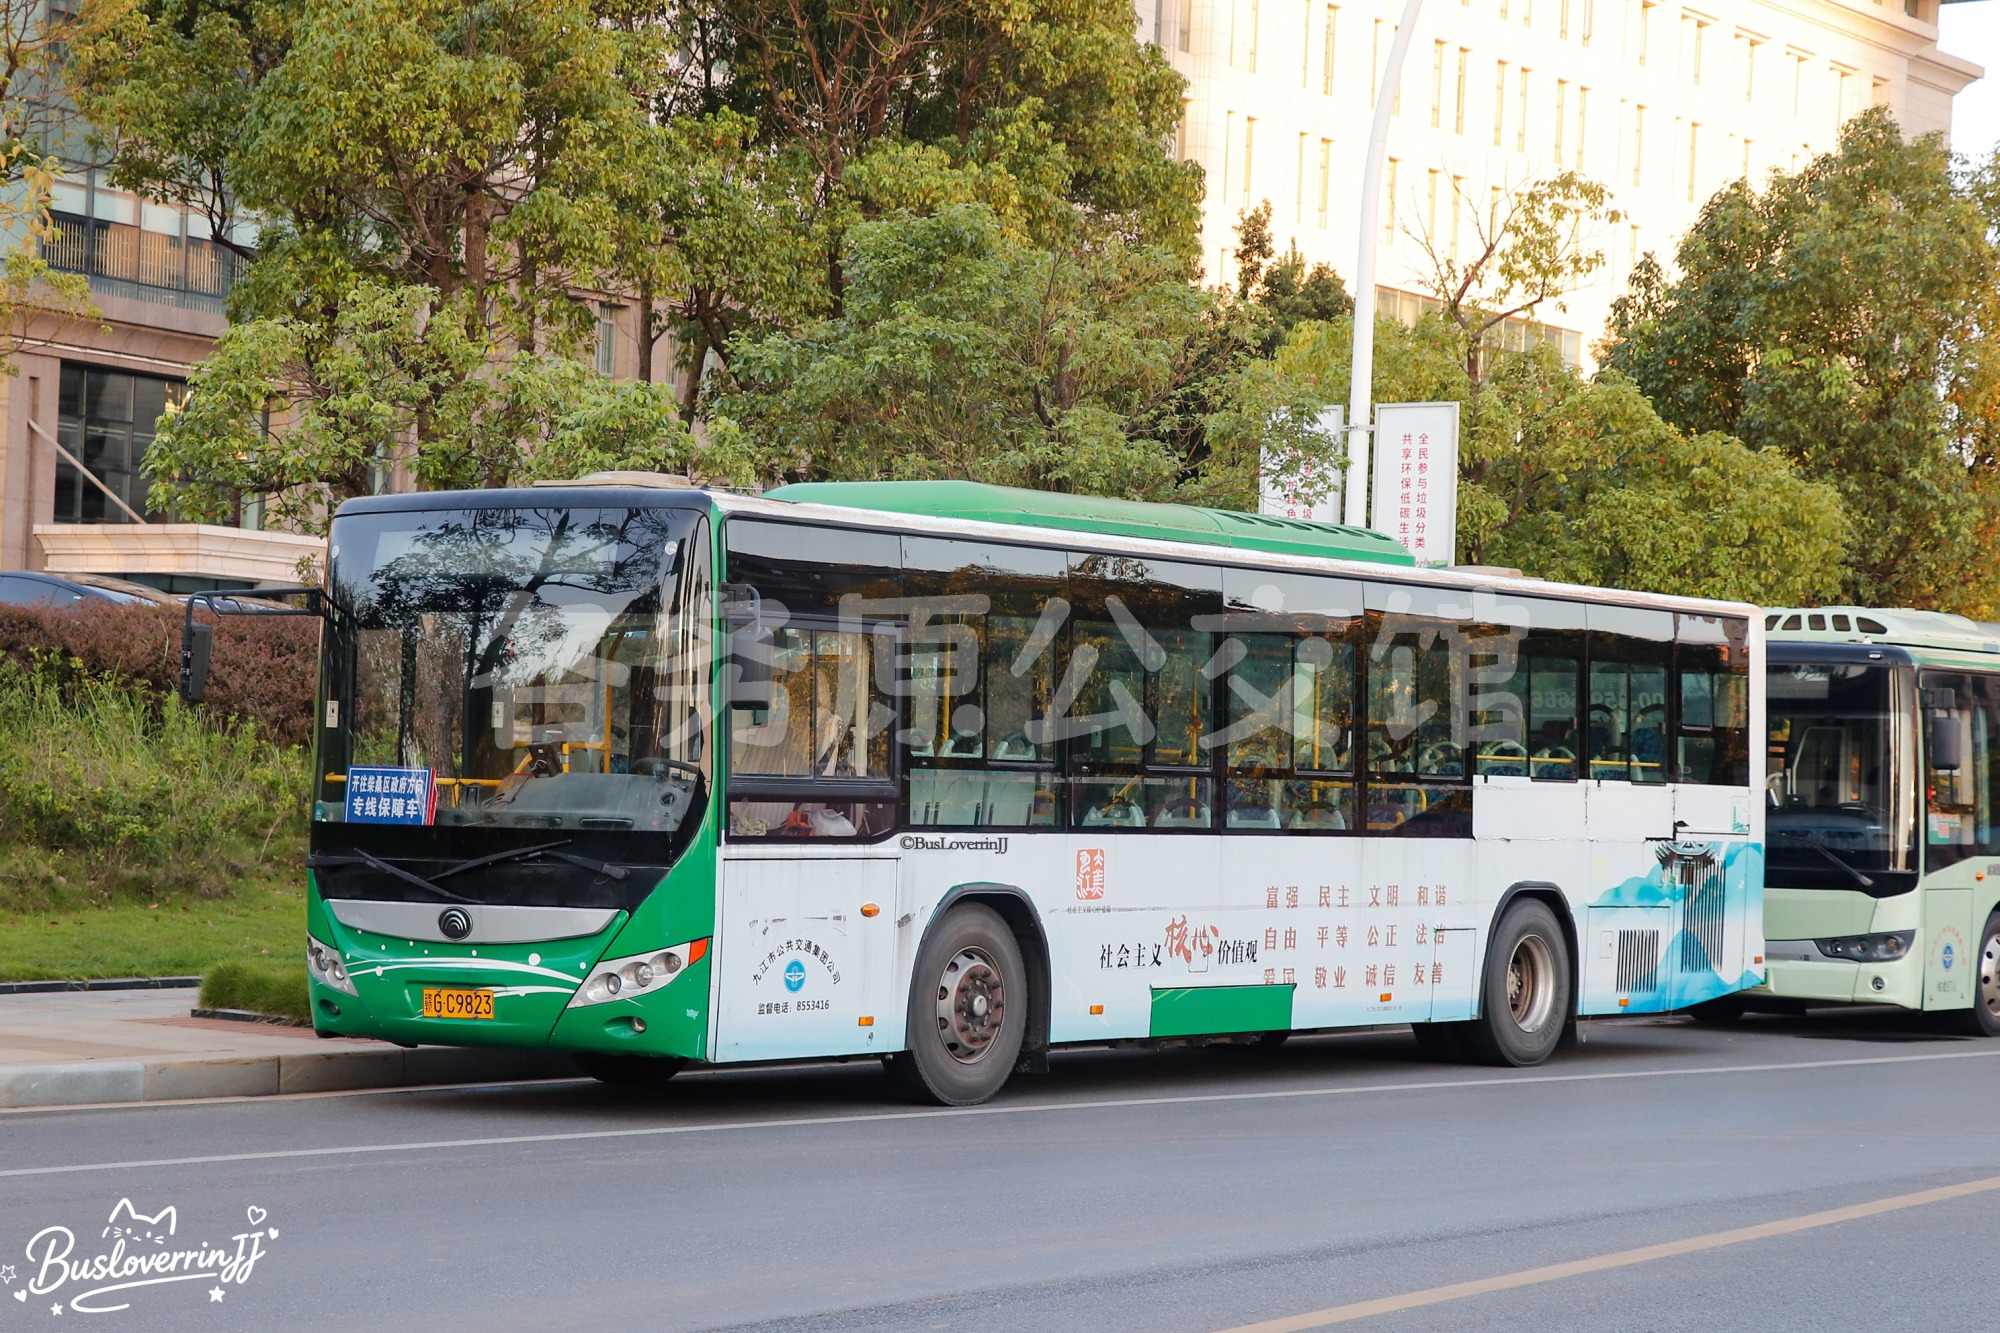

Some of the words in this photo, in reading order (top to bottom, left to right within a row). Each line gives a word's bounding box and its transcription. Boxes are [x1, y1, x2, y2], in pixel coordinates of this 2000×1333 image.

[1399, 432, 1413, 549] 共享环保低碳生活
[1414, 432, 1429, 549] 全民参与垃圾分类
[351, 775, 424, 795] 开往柴桑区政府方向
[352, 796, 419, 819] 专线保障车
[1266, 885, 1299, 909] 富强
[1319, 885, 1349, 908] 民主
[1368, 884, 1399, 908] 文明
[1416, 884, 1446, 906] 和谐
[1100, 914, 1258, 969] 社会主义核心价值观
[1264, 926, 1297, 950] 自由
[1316, 925, 1348, 949] 平等
[1367, 924, 1397, 947] 公正
[1415, 923, 1446, 945] 法治
[752, 938, 841, 985] 九江市公共交通集团公司
[1263, 967, 1295, 985] 爱国
[1314, 965, 1346, 989] 敬业
[1365, 963, 1395, 987] 诚信
[1413, 962, 1443, 985] 友善
[796, 1000, 830, 1012] 8553416
